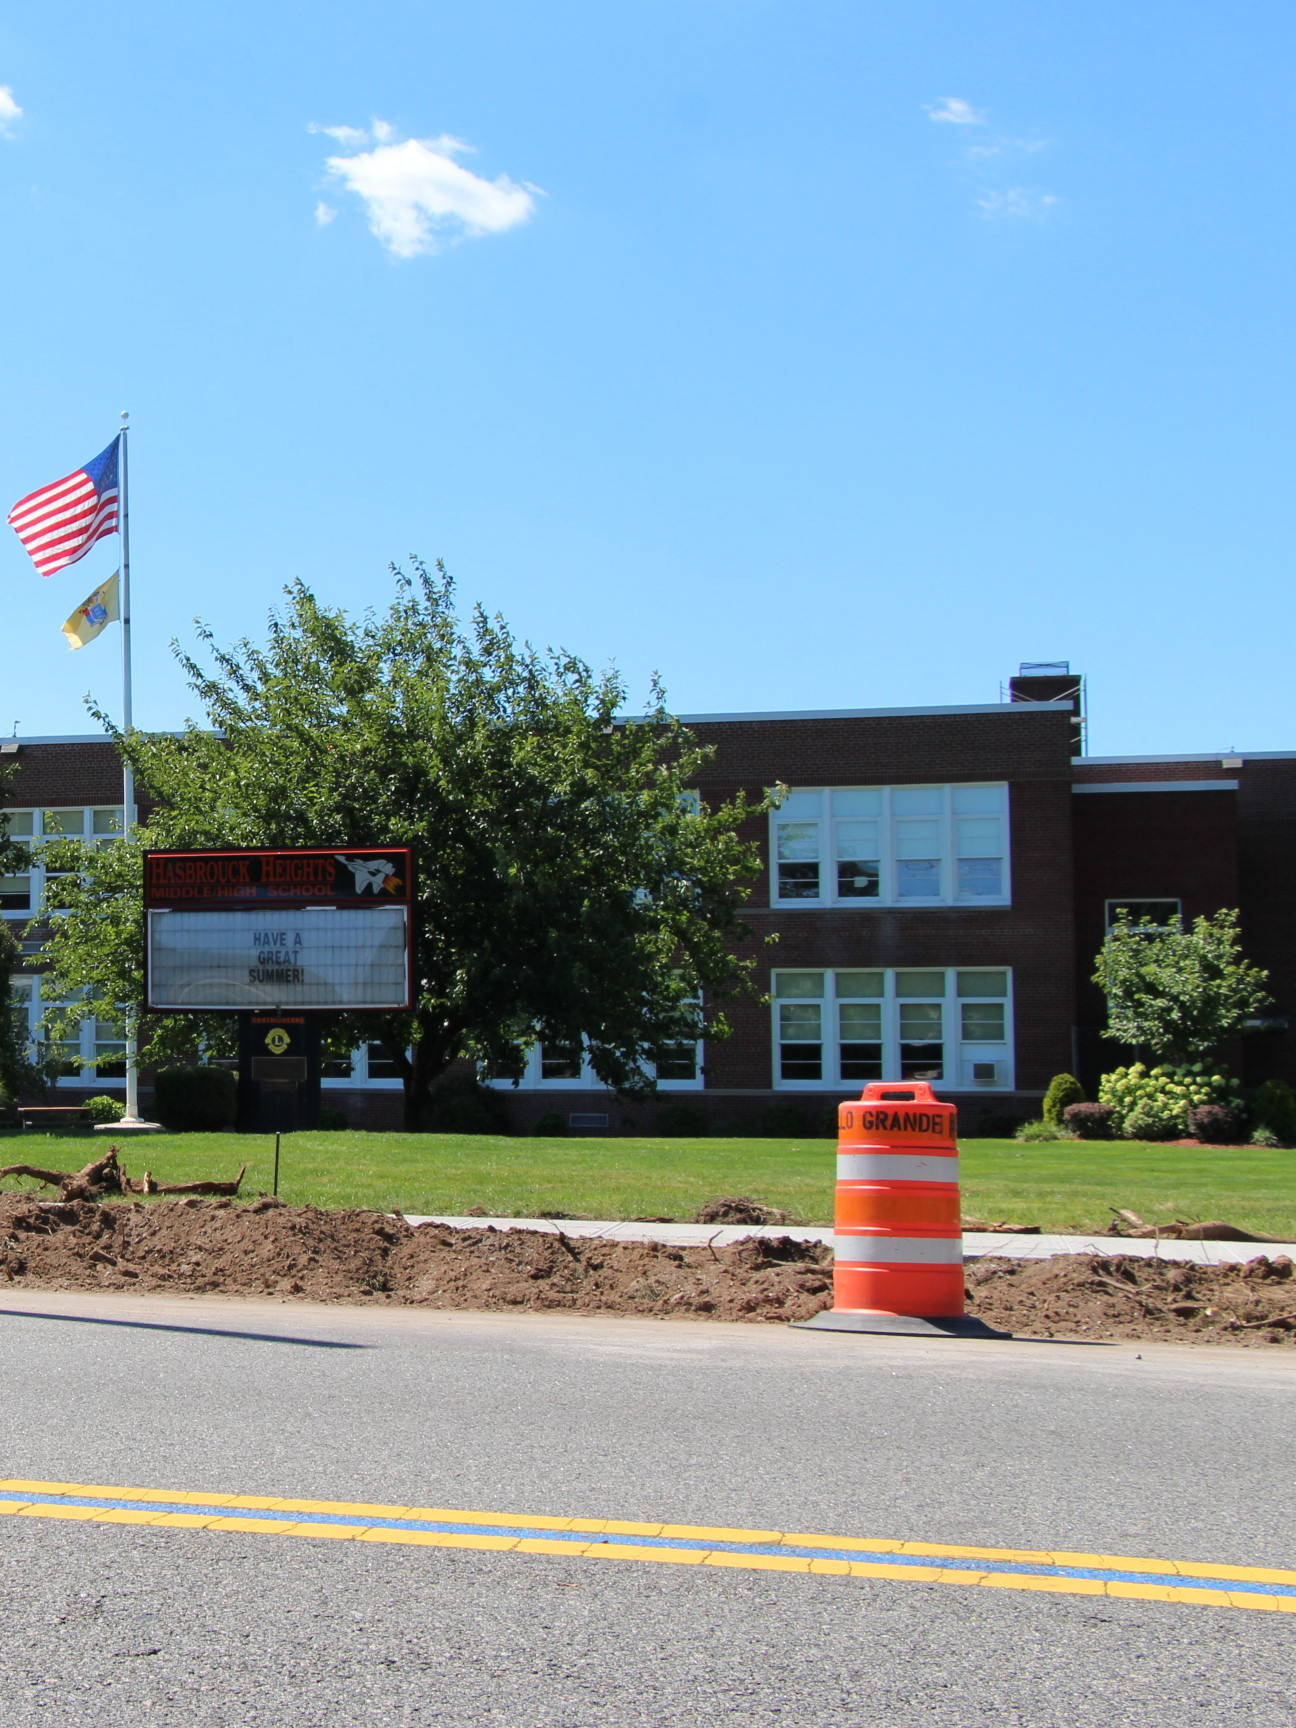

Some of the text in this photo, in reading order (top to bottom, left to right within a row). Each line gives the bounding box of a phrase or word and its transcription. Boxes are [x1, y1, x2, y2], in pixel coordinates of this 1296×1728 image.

[154, 855, 336, 884] HASBROUCK HEIGHTS
[154, 884, 336, 898] MIDDLE/HIGH SCHOOL
[253, 932, 302, 946] HAVE A
[258, 950, 299, 965] GREAT
[249, 968, 304, 984] SUMMER!
[862, 1110, 944, 1135] GRANDE
